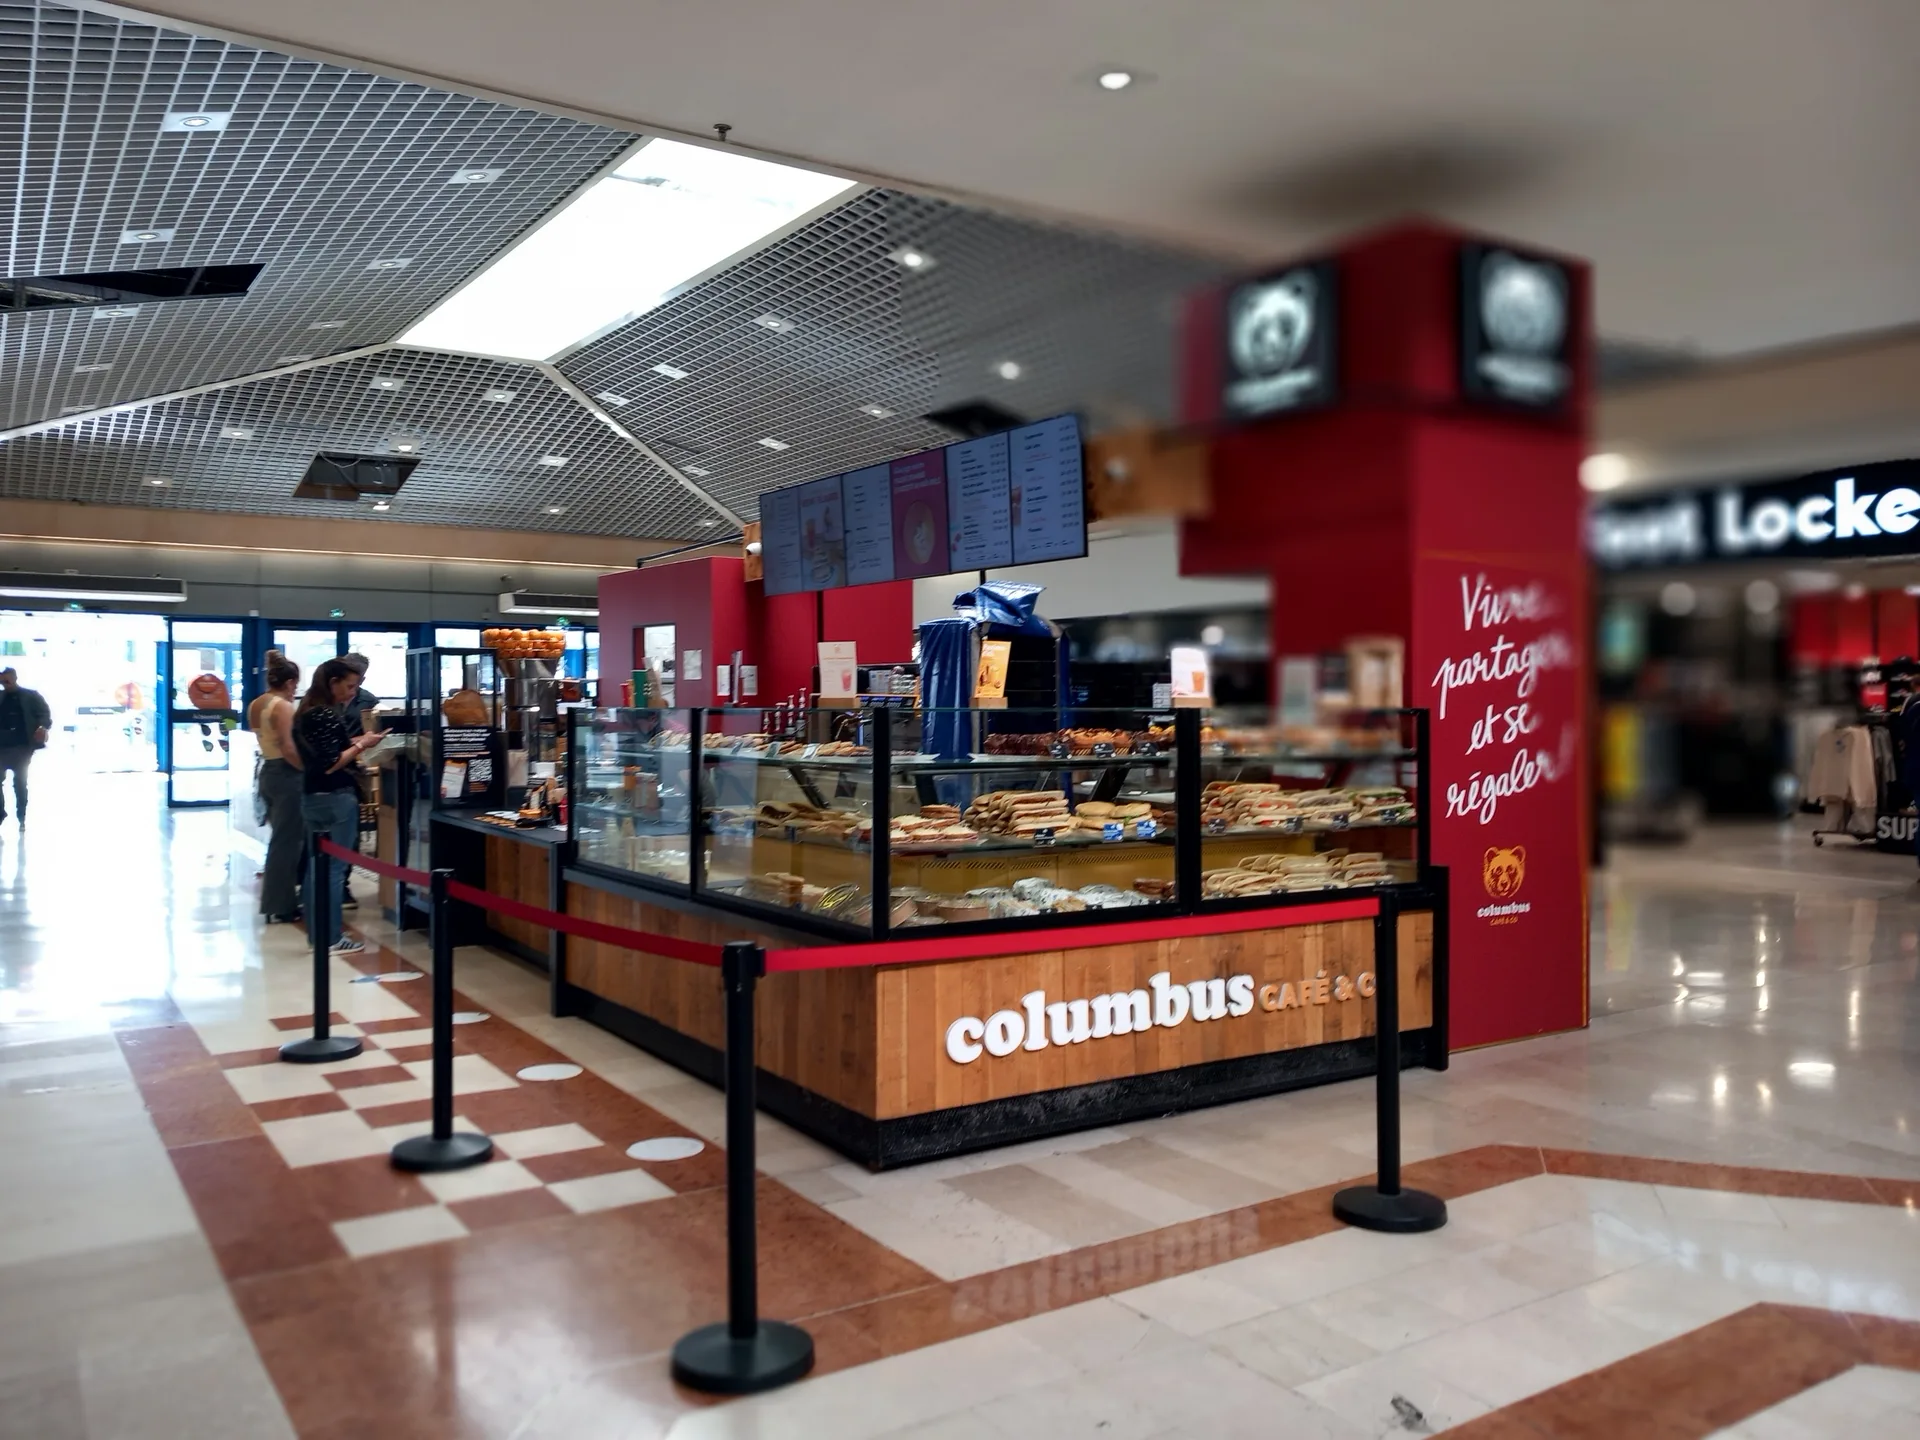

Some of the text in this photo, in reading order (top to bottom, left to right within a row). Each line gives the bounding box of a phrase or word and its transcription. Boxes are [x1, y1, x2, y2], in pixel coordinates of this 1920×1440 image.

[1716, 477, 1920, 548] Locke
[1465, 703, 1541, 756] et se
[1477, 902, 1531, 917] columbus
[945, 968, 1375, 1064] columbus CAFÉ & C
